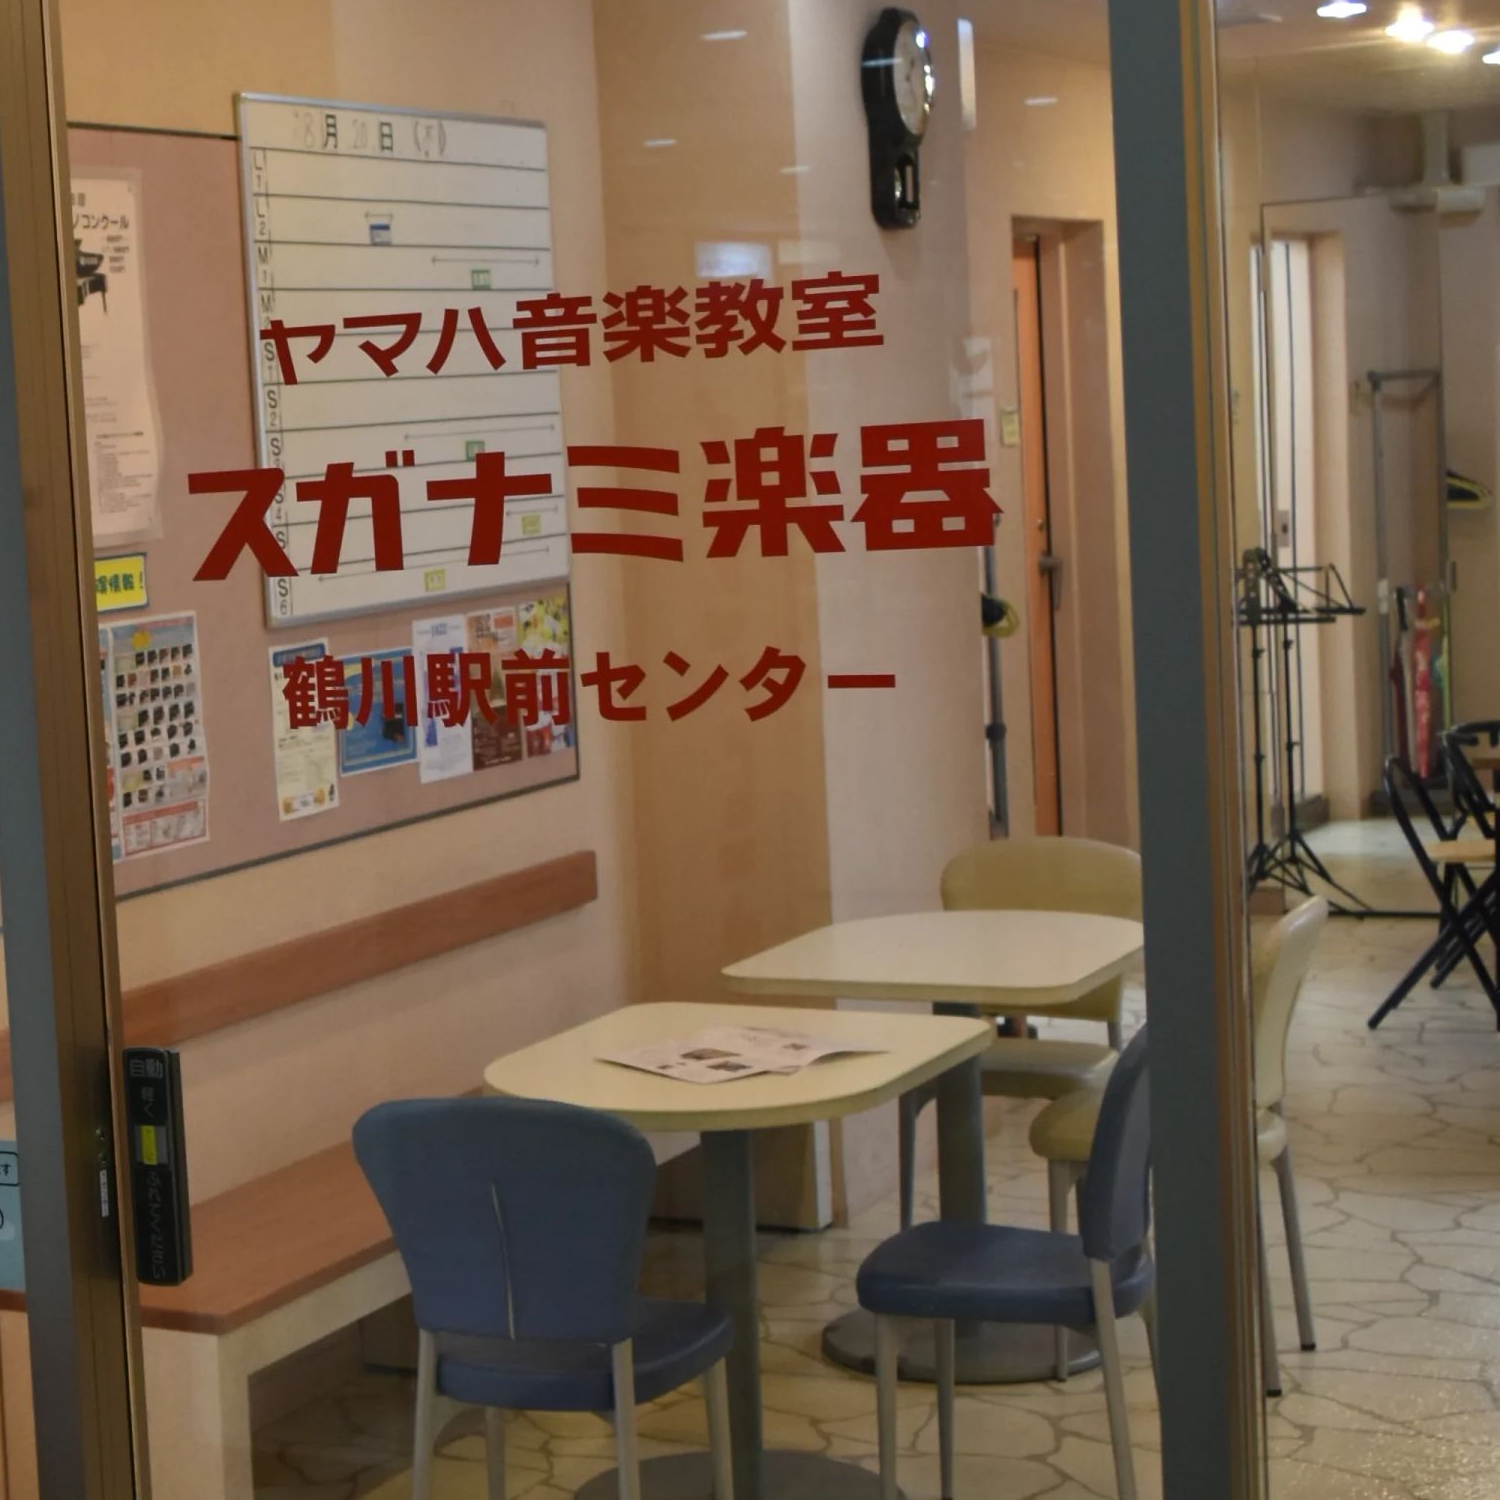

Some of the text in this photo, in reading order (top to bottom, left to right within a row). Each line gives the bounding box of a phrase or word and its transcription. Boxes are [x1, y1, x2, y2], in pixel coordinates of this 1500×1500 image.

[260, 271, 886, 386] ヤマハ音楽教室
[187, 418, 1004, 581] スガナミ楽器
[283, 645, 897, 729] 鶴川駅前センター
